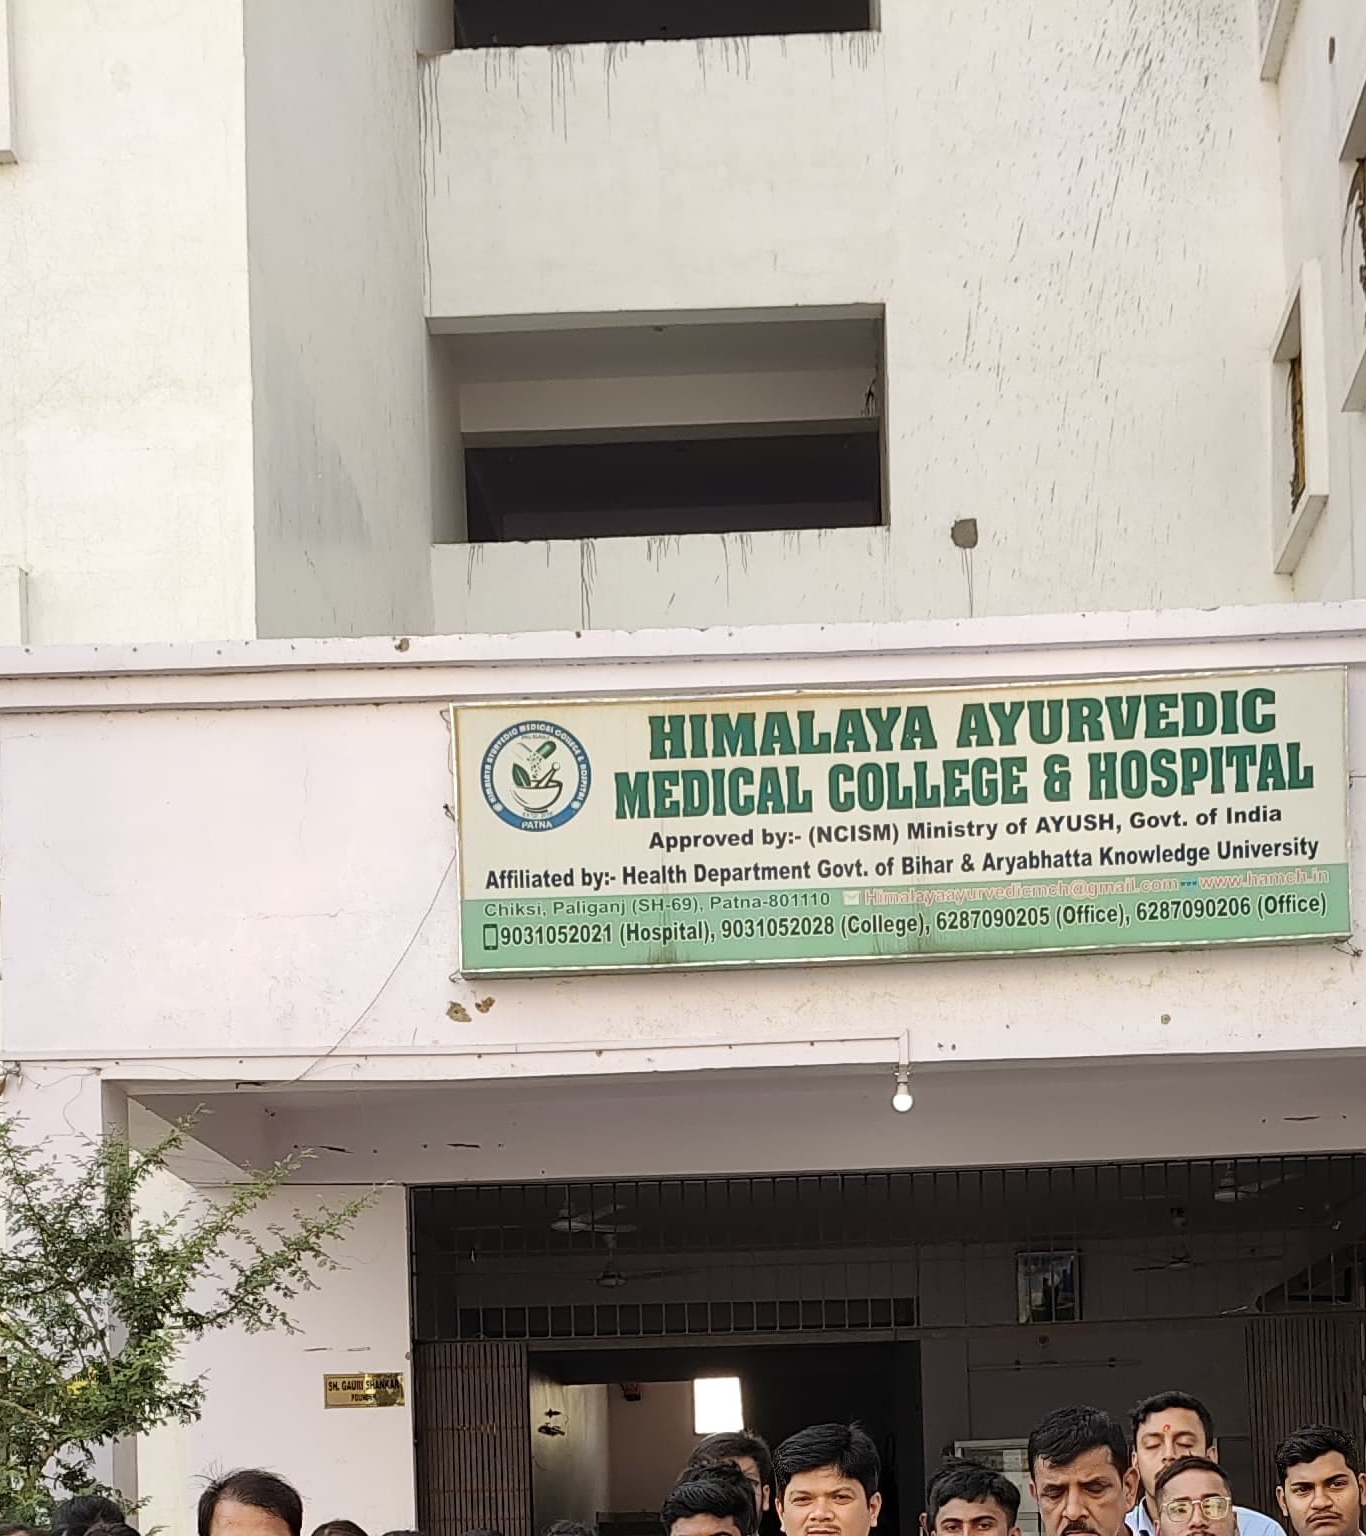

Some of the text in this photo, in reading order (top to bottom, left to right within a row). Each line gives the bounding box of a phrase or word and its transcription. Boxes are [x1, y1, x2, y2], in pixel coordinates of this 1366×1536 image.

[648, 688, 1276, 761] HIMALAYA AYURVEDIC
[614, 742, 1315, 820] MEDICAL COLLEGE & HOSPITAL
[522, 820, 553, 830] PATNA
[648, 805, 1282, 852] Approved by:- (NCISM) Ministry of AYUSH, Govt. of India
[485, 837, 1320, 890] Affiliated by:- Health Department Govt. of Bihar & Aryabhatta Knowledge University
[484, 901, 547, 919] Chiksi,
[553, 898, 627, 918] Paliganj
[631, 896, 704, 916] (SH-69),
[710, 892, 831, 910] Patna-801110
[501, 893, 1328, 946] 9031052021 (Hospital), 9031052028 (College), 6287090205 (Office), 6287090206 (Office)
